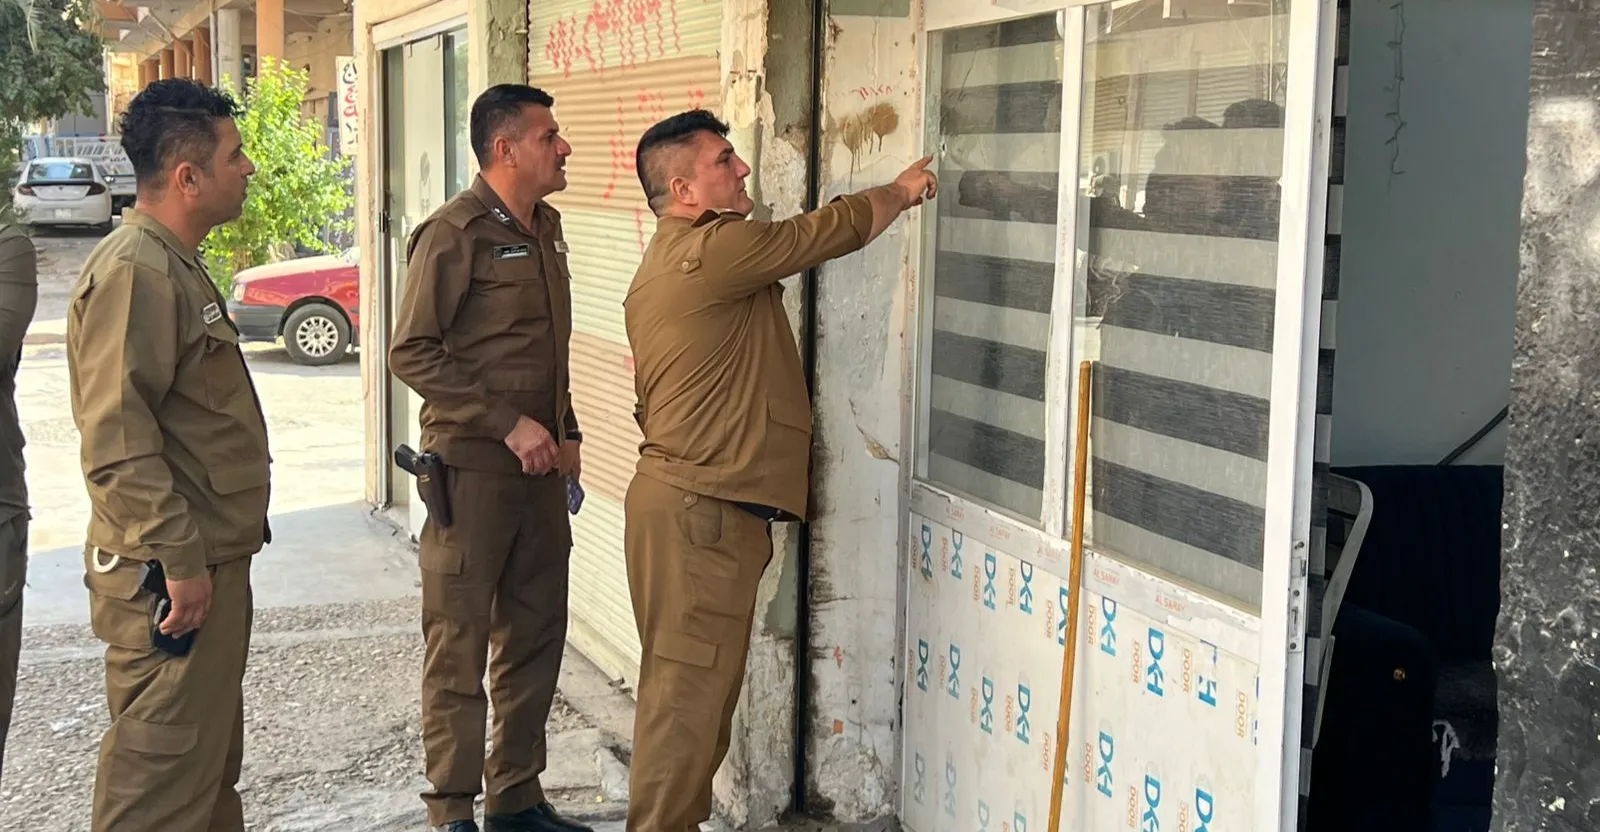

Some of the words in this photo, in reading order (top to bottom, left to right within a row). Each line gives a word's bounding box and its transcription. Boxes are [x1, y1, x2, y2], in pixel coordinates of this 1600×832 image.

[1132, 640, 1141, 684] DOOR
[1182, 648, 1191, 693] DOOR
[1236, 691, 1246, 738] DOOR
